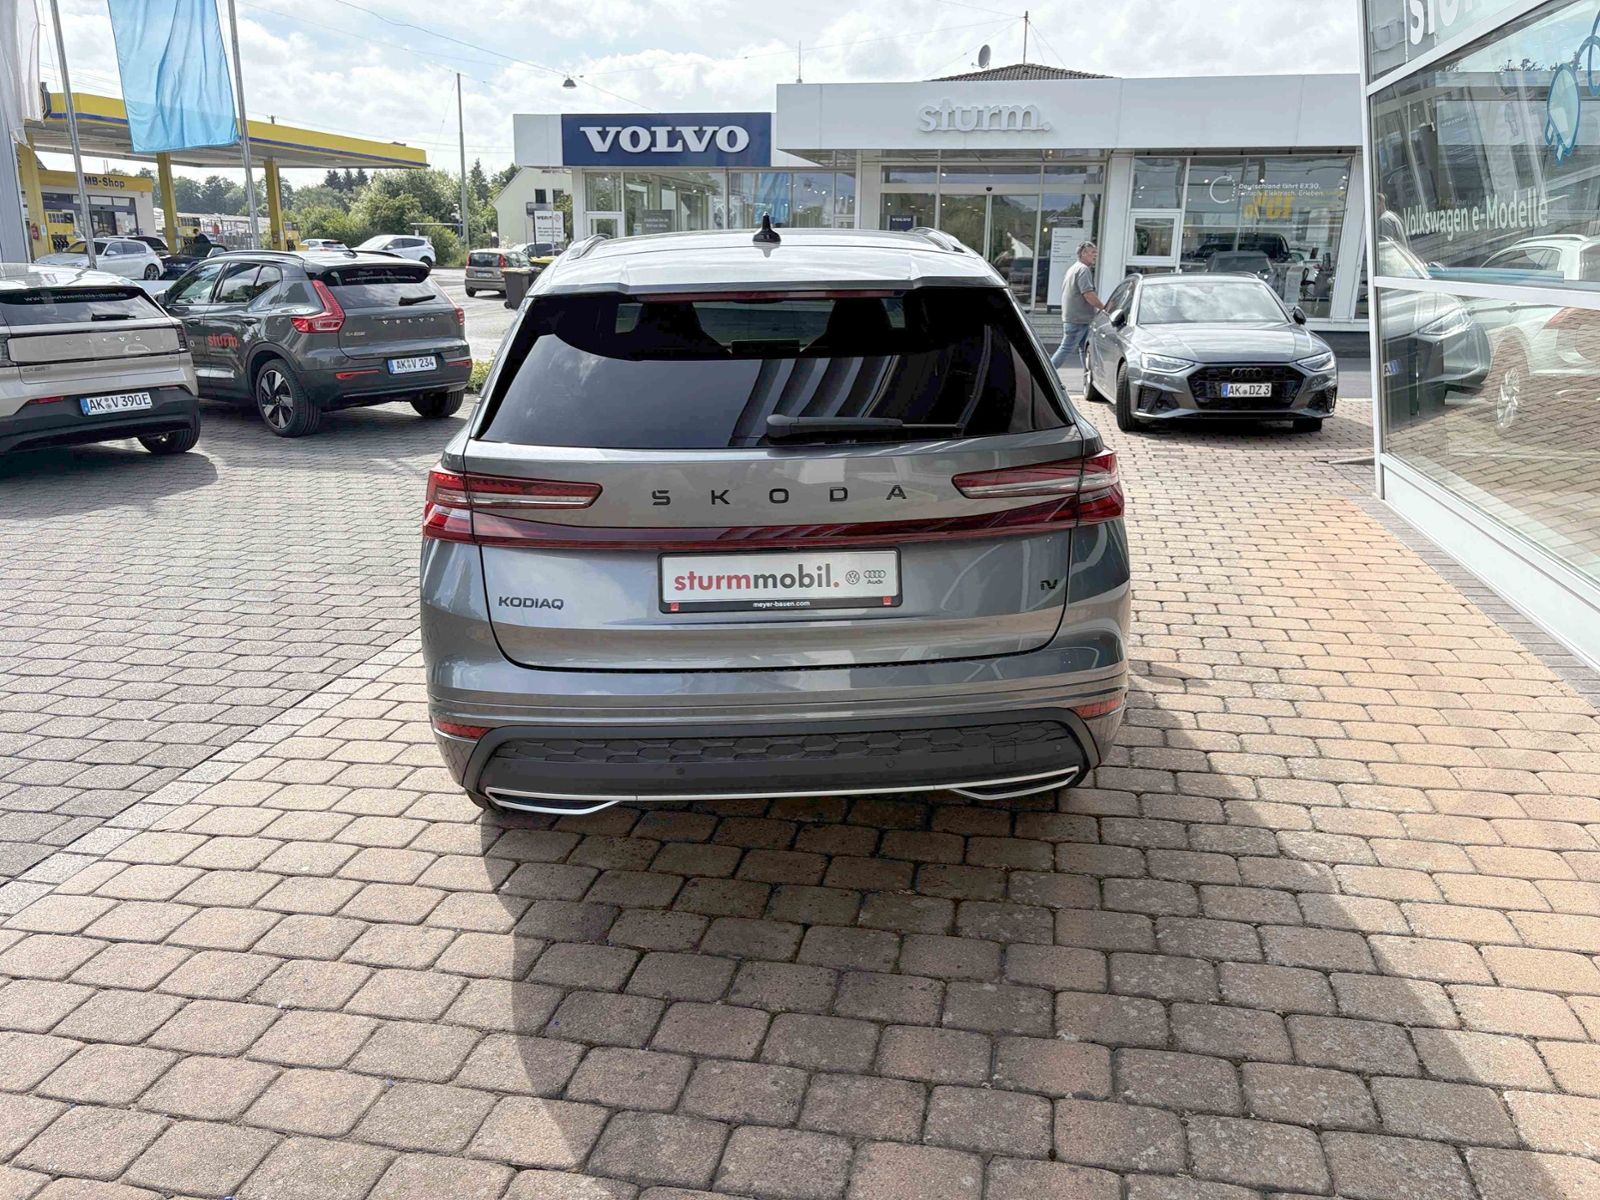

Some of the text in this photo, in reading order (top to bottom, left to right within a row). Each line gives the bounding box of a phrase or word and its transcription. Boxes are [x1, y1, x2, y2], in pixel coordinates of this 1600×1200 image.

[919, 98, 1053, 132] sturm.
[579, 125, 750, 153] VOLVO
[1403, 188, 1549, 242] Volkswagen e-Modelle
[396, 359, 408, 370] AK
[418, 356, 435, 368] 234
[1229, 384, 1270, 395] AK DZ 3
[90, 392, 151, 410] AK V 390E
[651, 484, 908, 506] SKODA
[674, 563, 840, 591] sturmmobil.
[498, 596, 564, 611] KODIAQ
[752, 600, 811, 608] meyer-bauen.com
